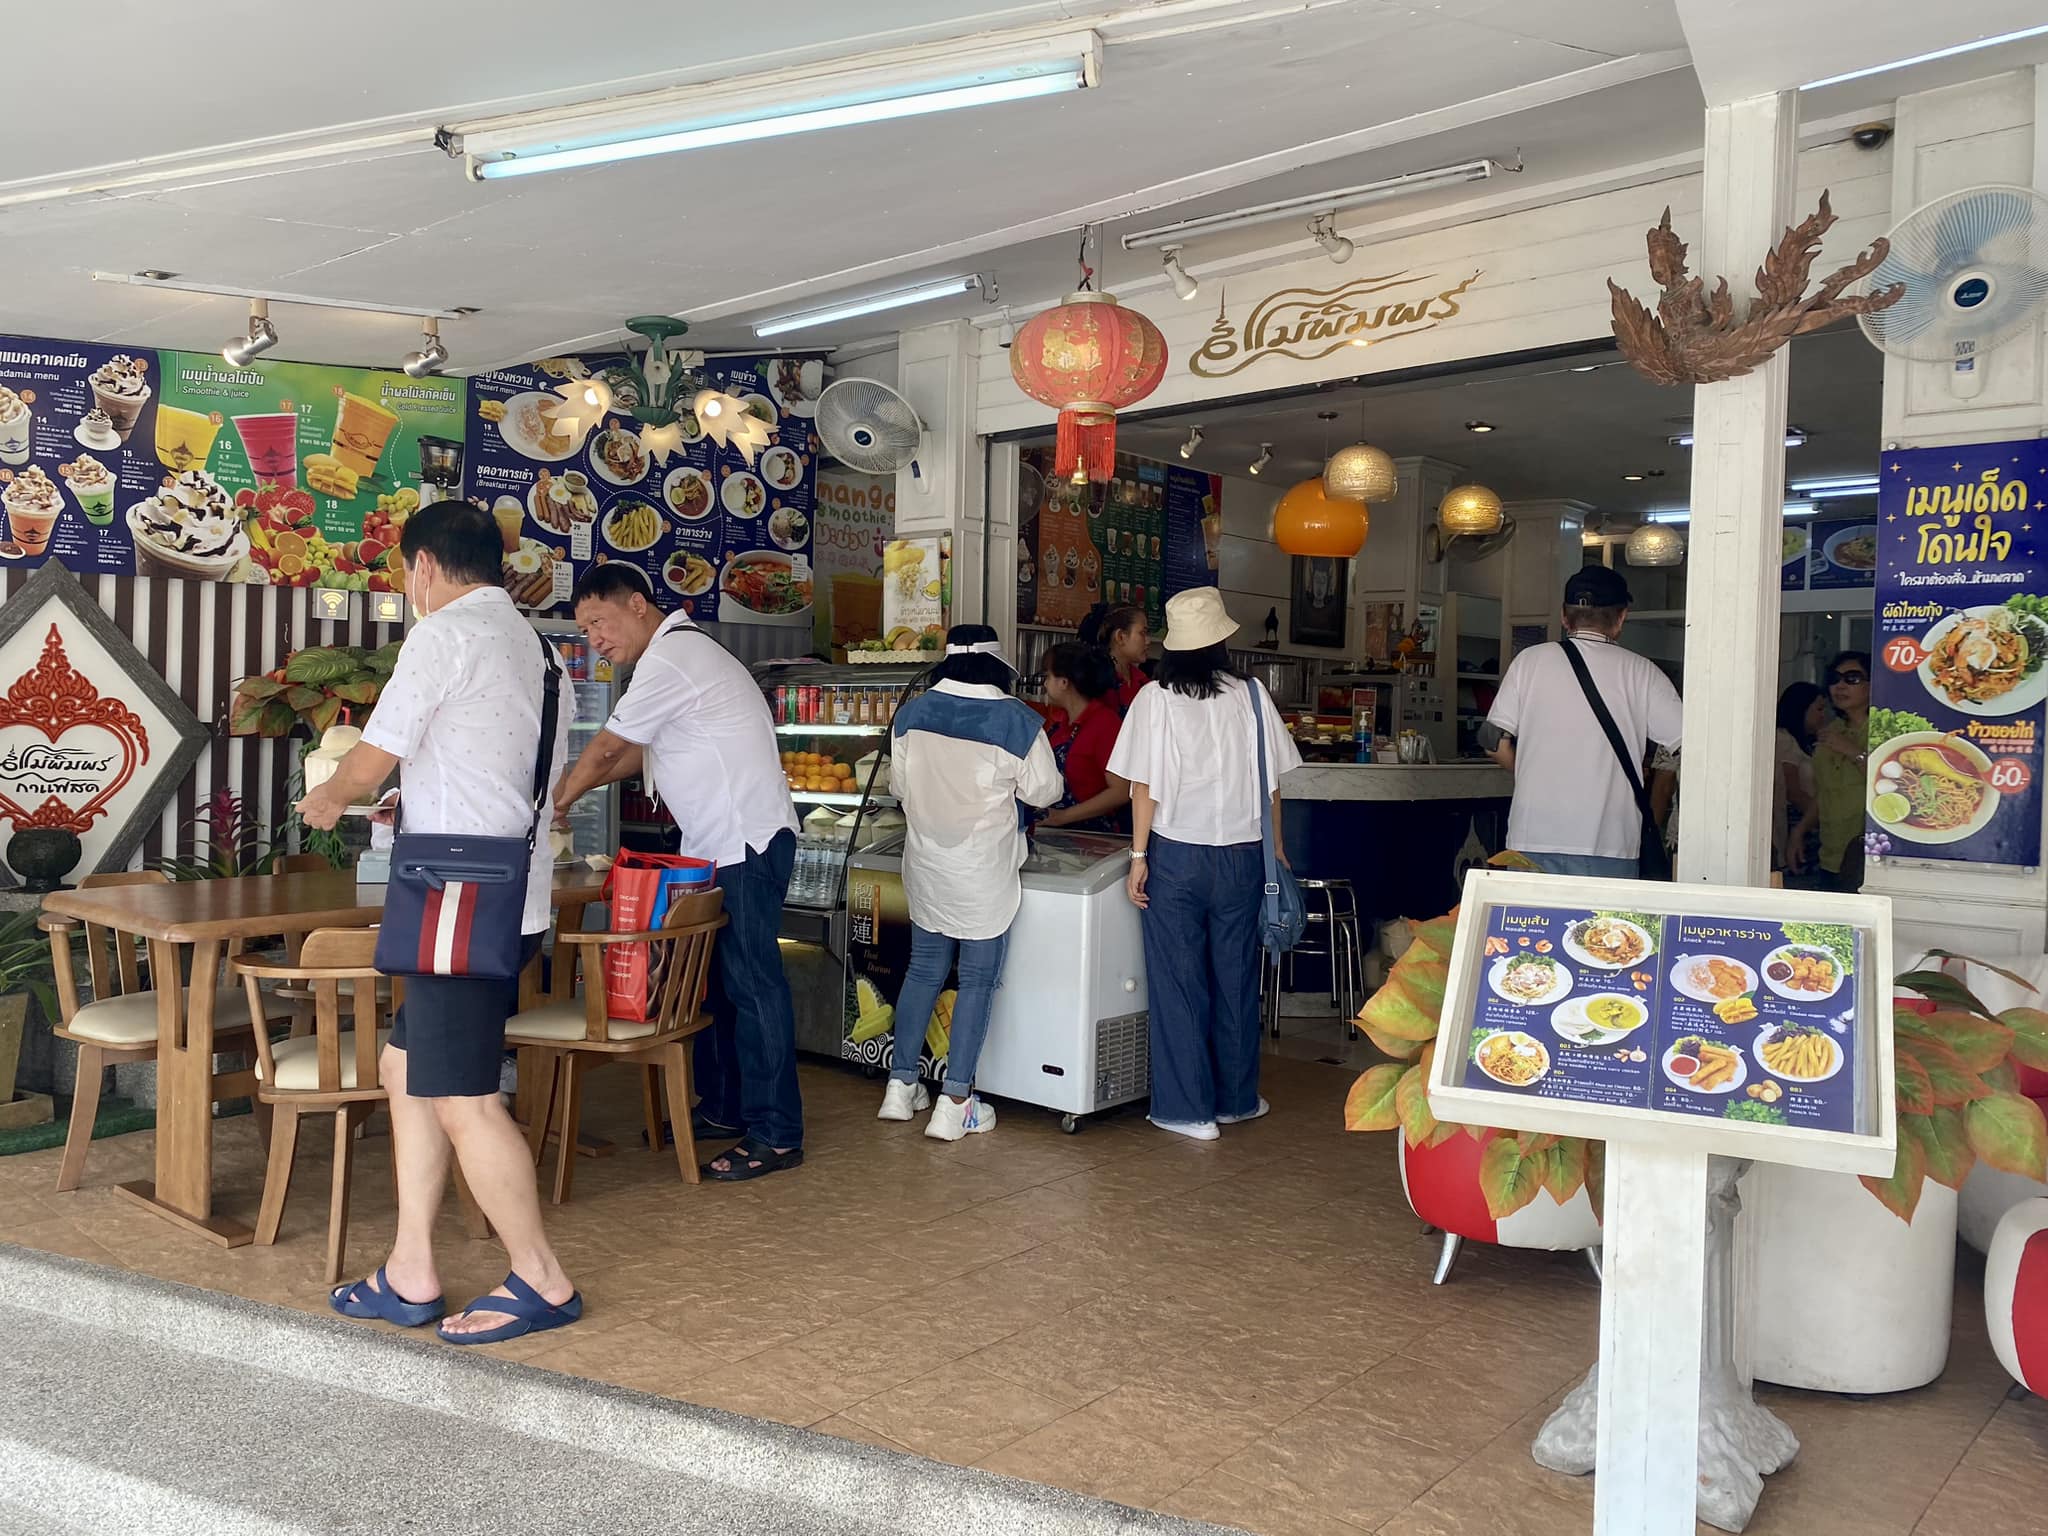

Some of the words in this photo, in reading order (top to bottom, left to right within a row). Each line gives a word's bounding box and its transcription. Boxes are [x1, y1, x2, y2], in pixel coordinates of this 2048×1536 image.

[34, 371, 60, 381] menu
[182, 386, 220, 396] Smoothie
[300, 404, 312, 414] 17
[218, 441, 232, 450] 16
[325, 500, 338, 509] 18
[1905, 467, 2028, 528] เมนูเด็ด
[1916, 513, 2012, 564] โดนใจ
[1882, 600, 1944, 623] ผัดไทยกุ้ง
[1889, 645, 1925, 666] 70.-
[1991, 764, 2030, 787] 60.-
[16, 780, 100, 794] กาแฟสด
[1506, 914, 1550, 928] เมนูเส้น
[1684, 926, 1772, 941] เมนูอาหารว่าง
